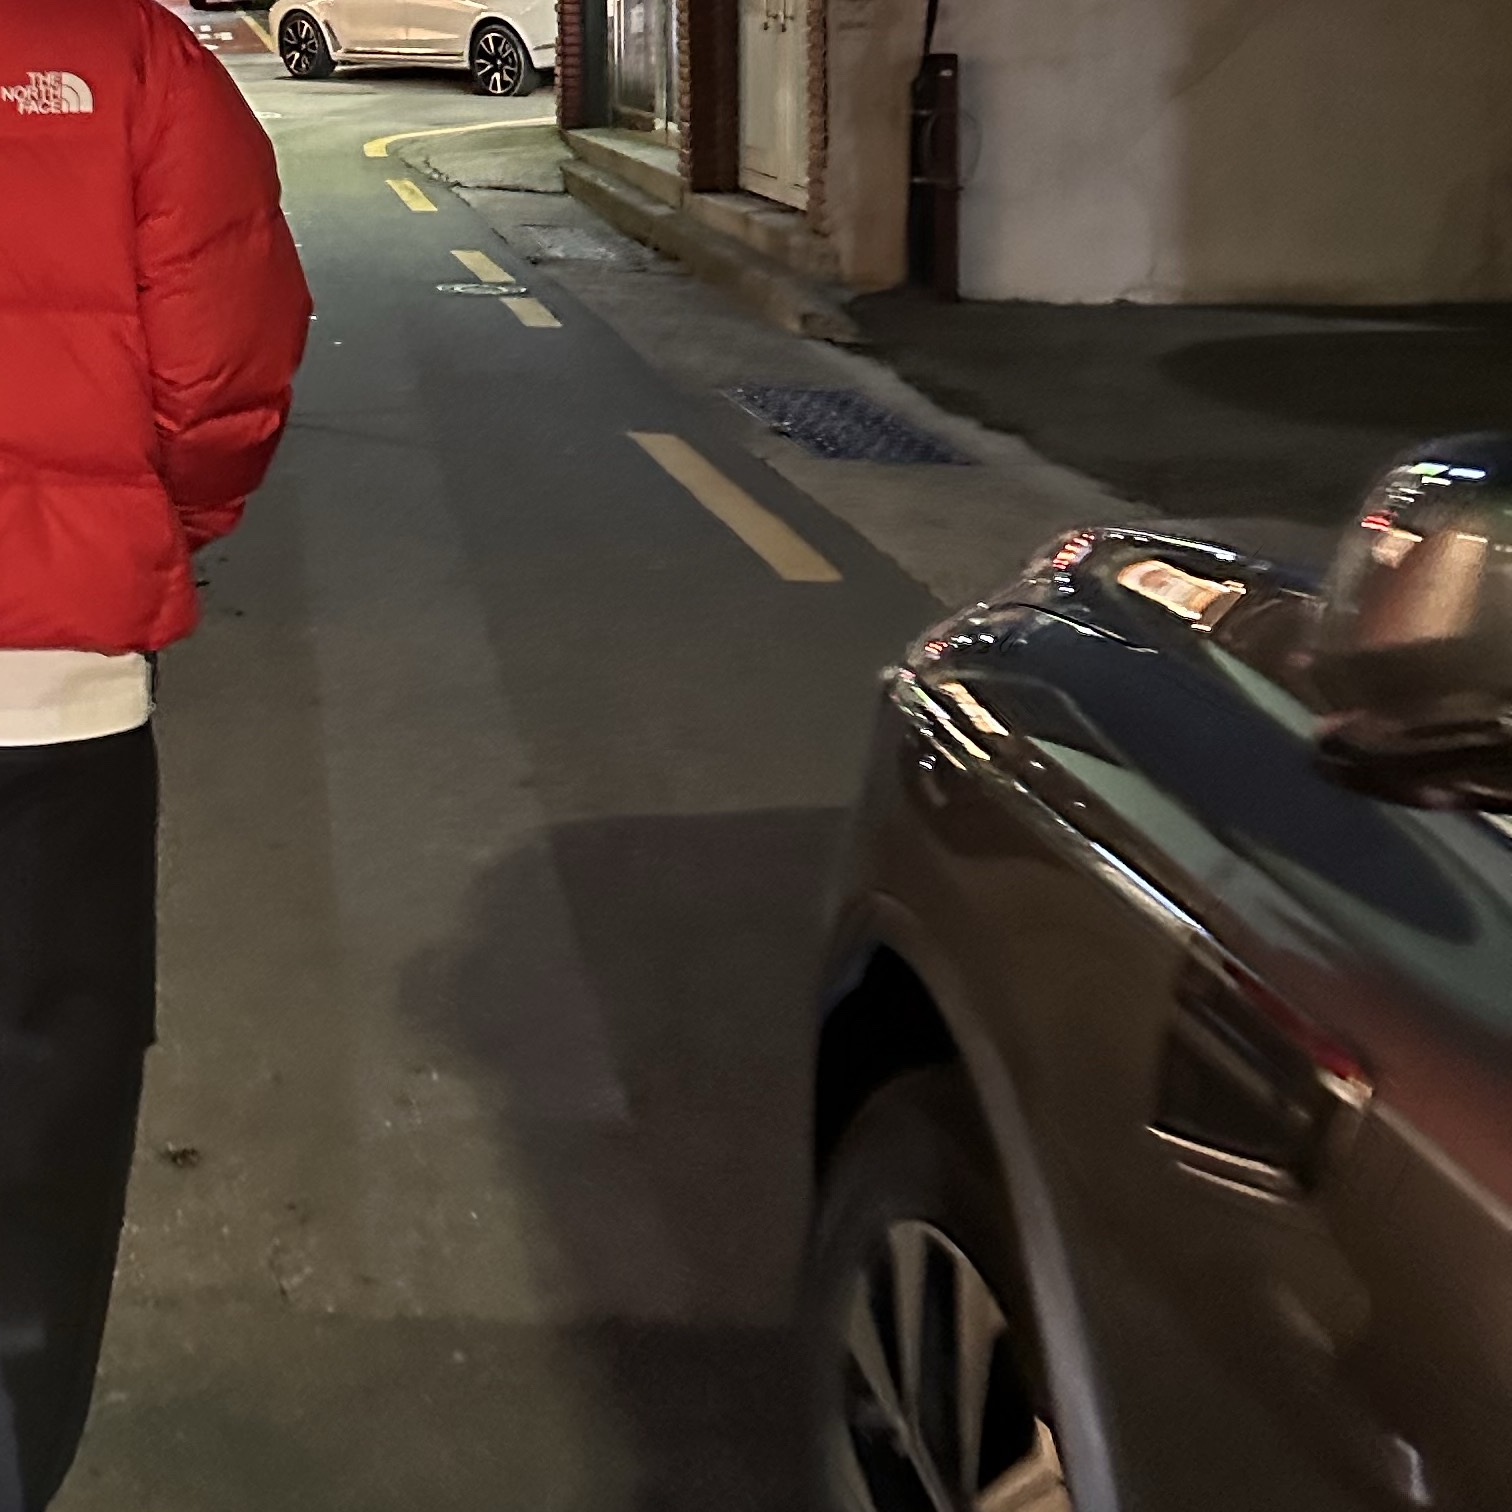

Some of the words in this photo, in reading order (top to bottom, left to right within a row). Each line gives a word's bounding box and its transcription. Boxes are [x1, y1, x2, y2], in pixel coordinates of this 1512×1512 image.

[26, 71, 62, 88] THE
[0, 84, 62, 102] NORTH
[17, 98, 62, 115] FACE
